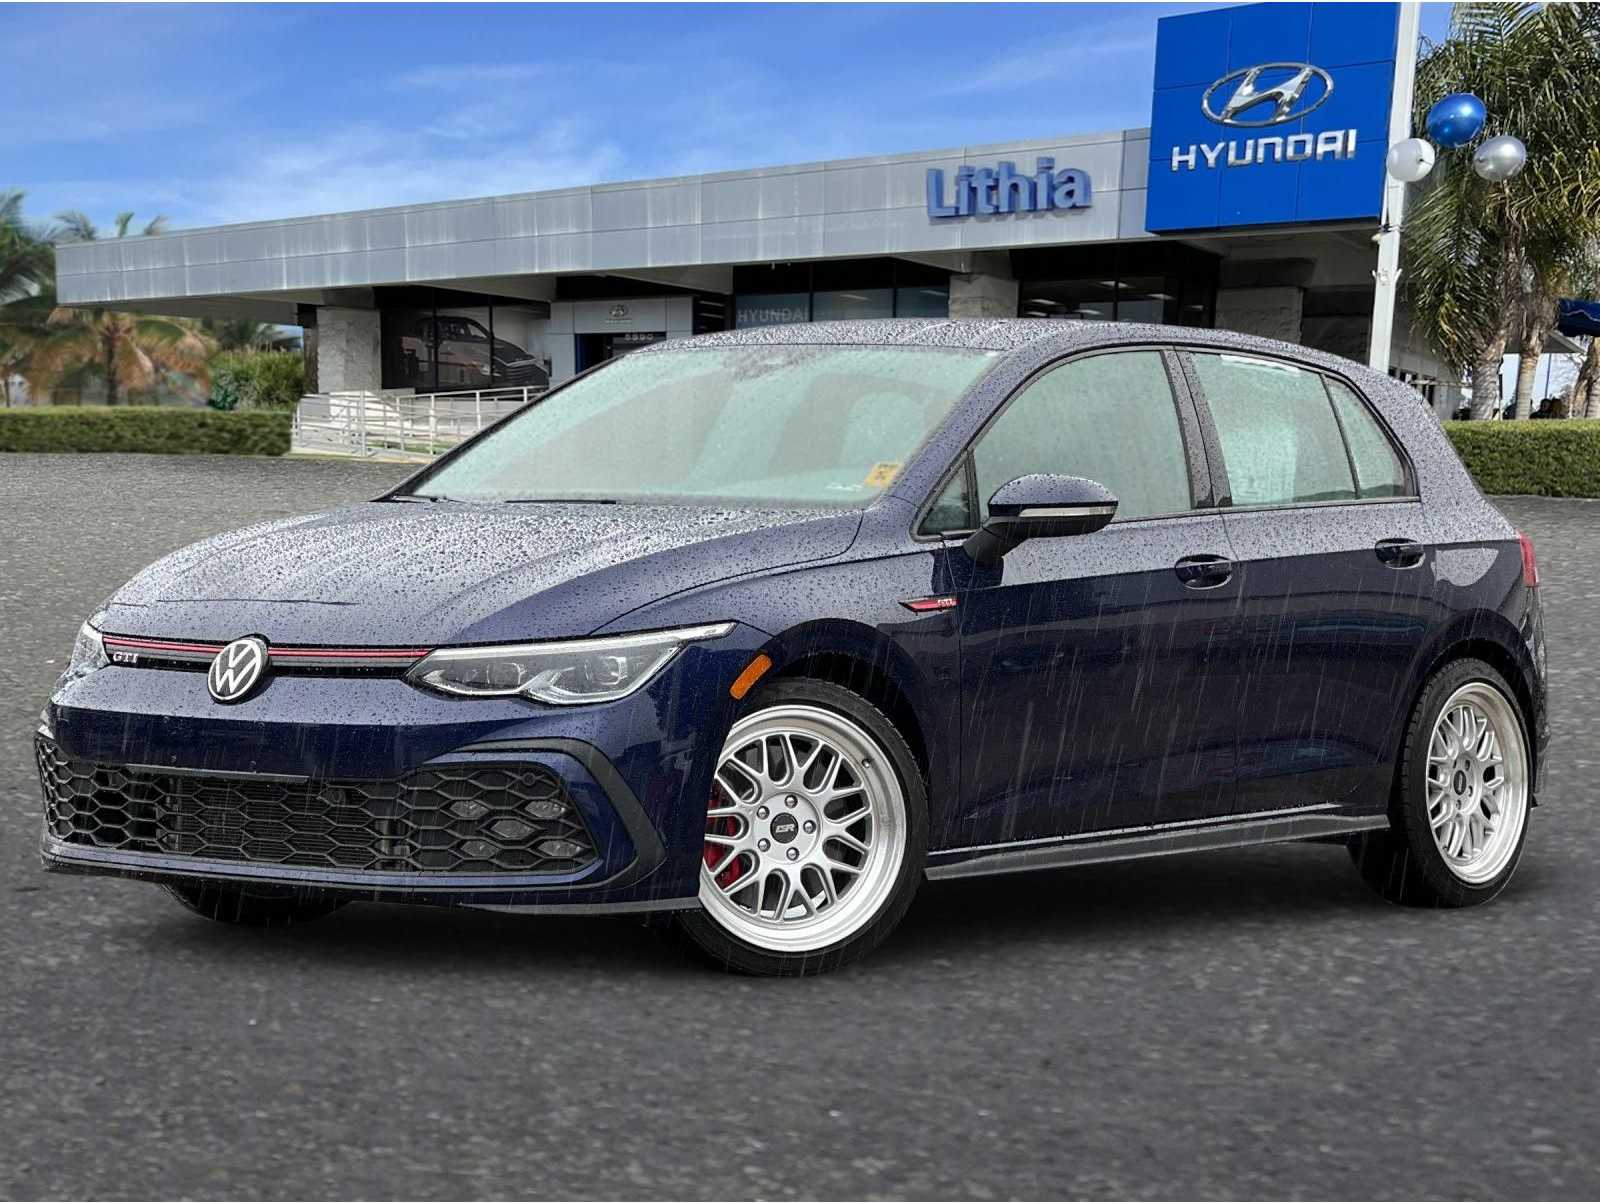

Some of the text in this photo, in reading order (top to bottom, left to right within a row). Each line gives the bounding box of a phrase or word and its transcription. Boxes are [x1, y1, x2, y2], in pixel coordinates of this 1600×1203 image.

[1171, 129, 1357, 171] HYUNDAI
[927, 157, 1092, 217] Lithia
[737, 307, 809, 322] HYUNDAI
[112, 651, 139, 663] GTI
